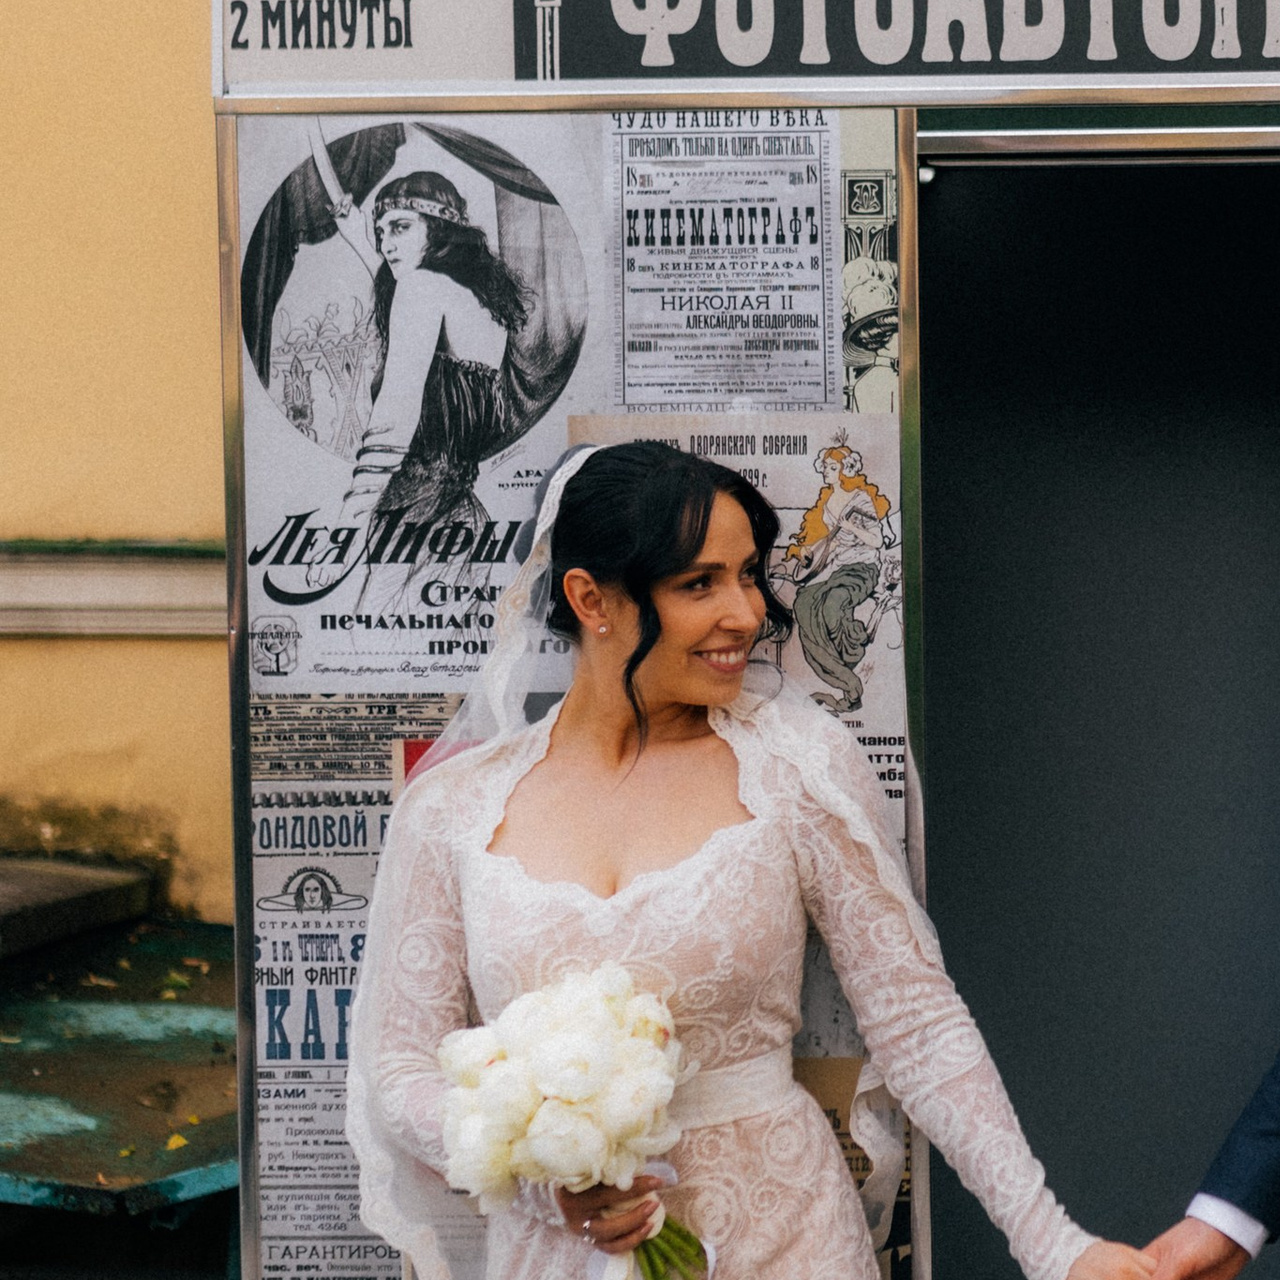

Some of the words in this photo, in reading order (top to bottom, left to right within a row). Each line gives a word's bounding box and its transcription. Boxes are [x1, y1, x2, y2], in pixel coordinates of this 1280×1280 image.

[230, 0, 250, 51] 2
[612, 110, 667, 130] ЧУДО
[676, 110, 760, 129] НАШЕГО
[770, 109, 828, 127] ВѢКА.
[682, 136, 716, 157] ТОЛЬКО
[717, 136, 730, 157] НА
[731, 136, 762, 158] ОДИНЪ
[627, 166, 638, 187] 18
[806, 164, 818, 184] 18
[626, 206, 819, 247] КИНЕМАТОГРАФЪ
[646, 248, 686, 256] ЖИВЫЯ
[627, 257, 636, 272] 18
[660, 260, 805, 271] КИНЕМАТОГРАФА
[811, 256, 819, 271] 18
[660, 295, 770, 311] НИКОЛАЯ
[781, 294, 794, 310] II
[686, 314, 749, 330] АЛЕКСАНДРЫ
[762, 434, 808, 456] СОБРАНІЯ
[258, 920, 367, 930] СТРАИВАЕТС
